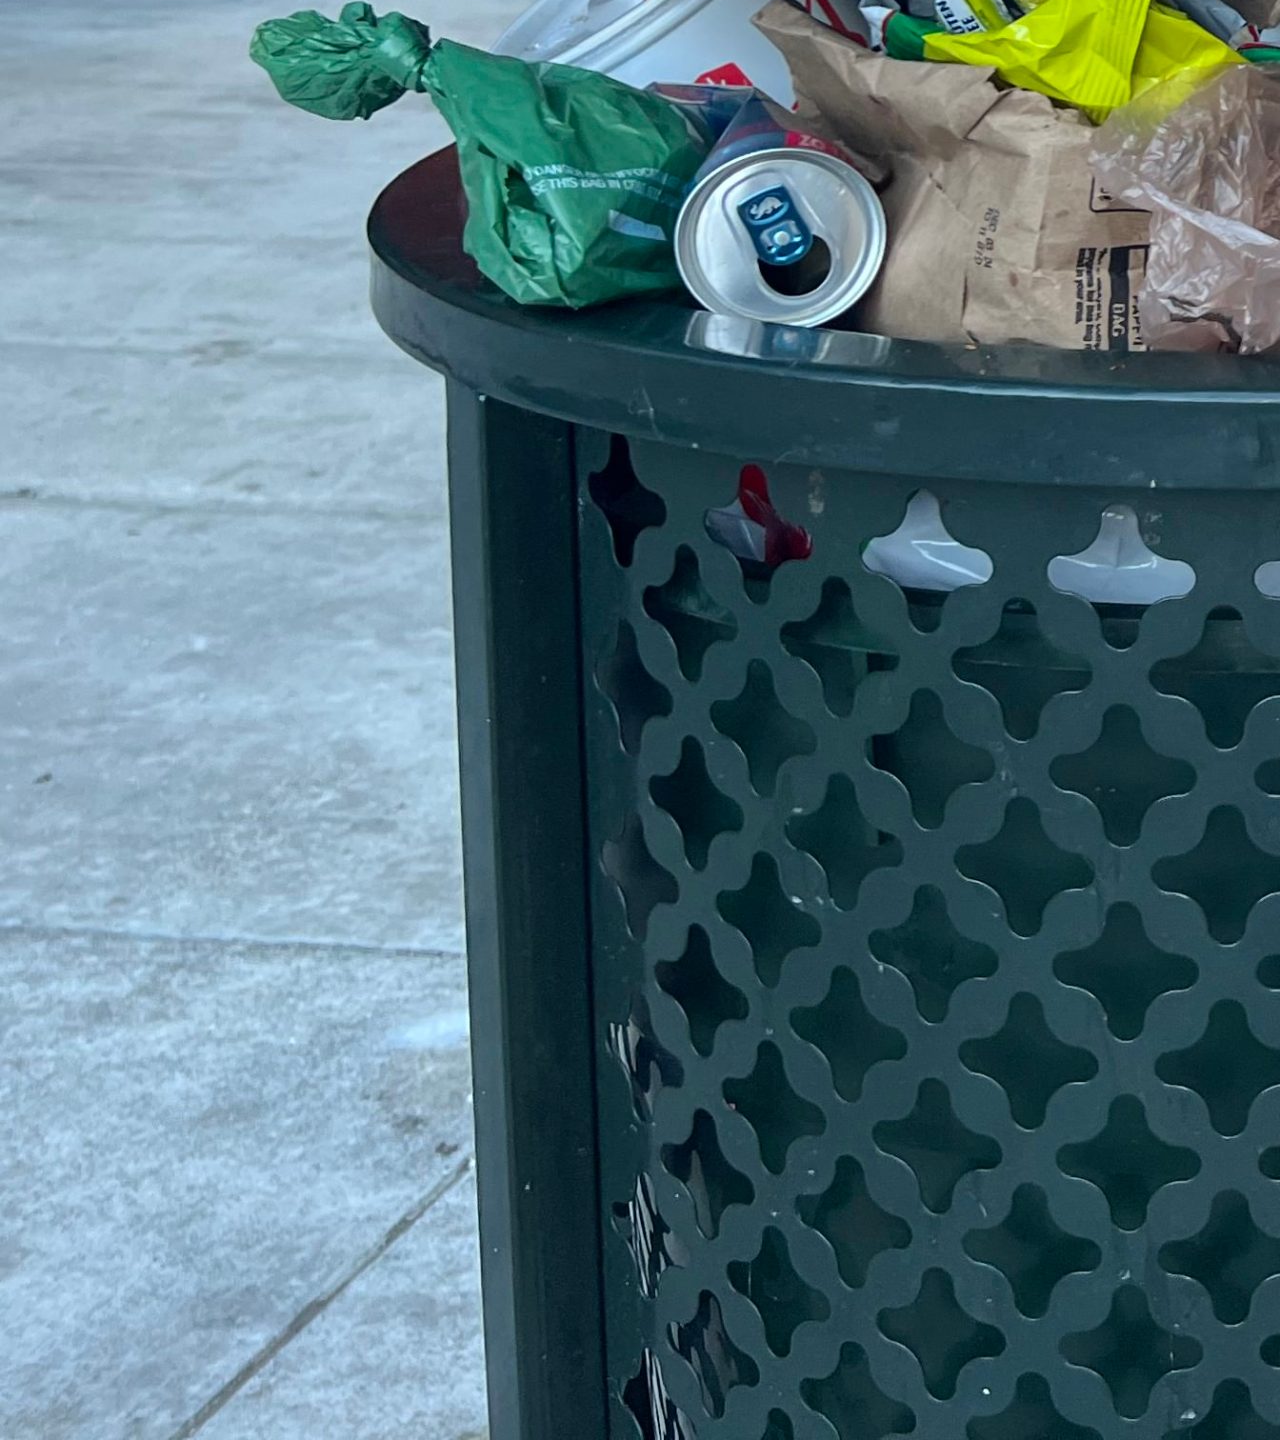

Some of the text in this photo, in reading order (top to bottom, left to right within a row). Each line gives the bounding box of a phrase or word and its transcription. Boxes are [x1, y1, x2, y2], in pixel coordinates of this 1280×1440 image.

[550, 177, 579, 190] THIS
[1074, 279, 1083, 300] your
[1112, 303, 1126, 338] BAG
[1082, 324, 1094, 342] bag
